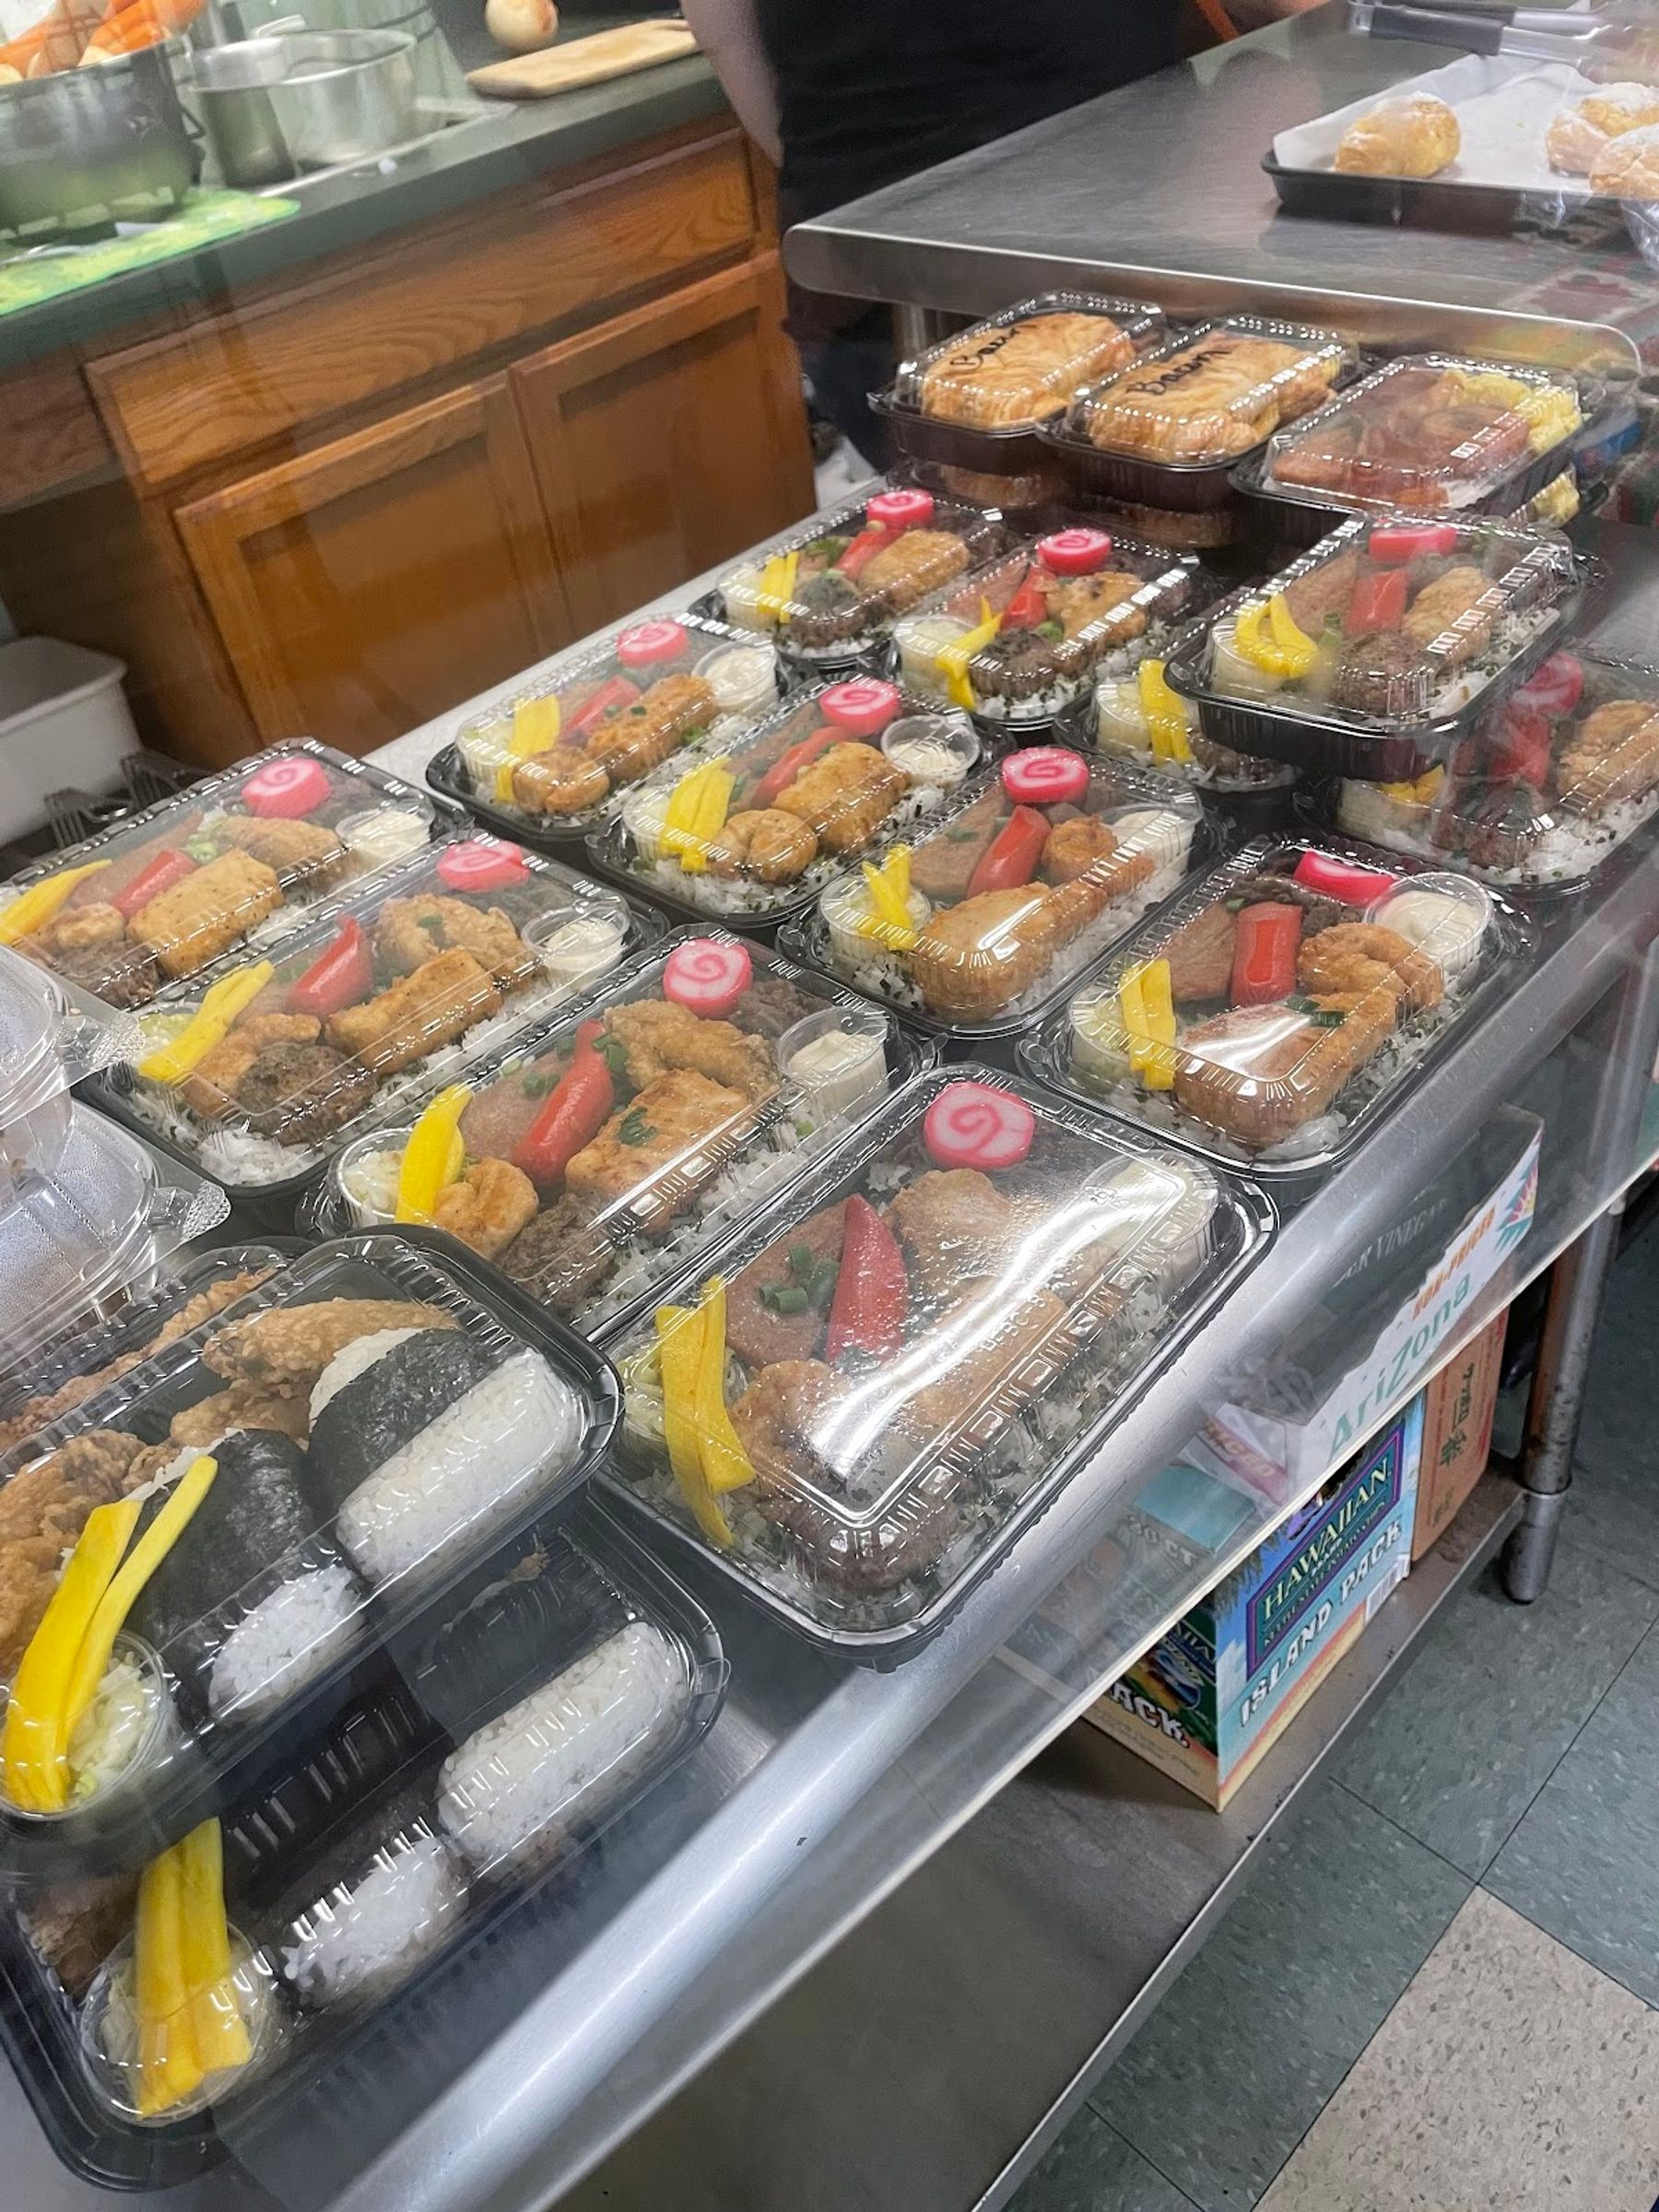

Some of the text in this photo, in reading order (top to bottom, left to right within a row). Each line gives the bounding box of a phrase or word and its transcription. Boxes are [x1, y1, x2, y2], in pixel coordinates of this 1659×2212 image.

[1328, 1274, 1472, 1467] AriZona
[1240, 1599, 1334, 1728] ISLAND
[1340, 1519, 1404, 1606] PACK
[1265, 1458, 1391, 1620] HAWAIIAN
[1110, 1680, 1186, 1747] ACK
